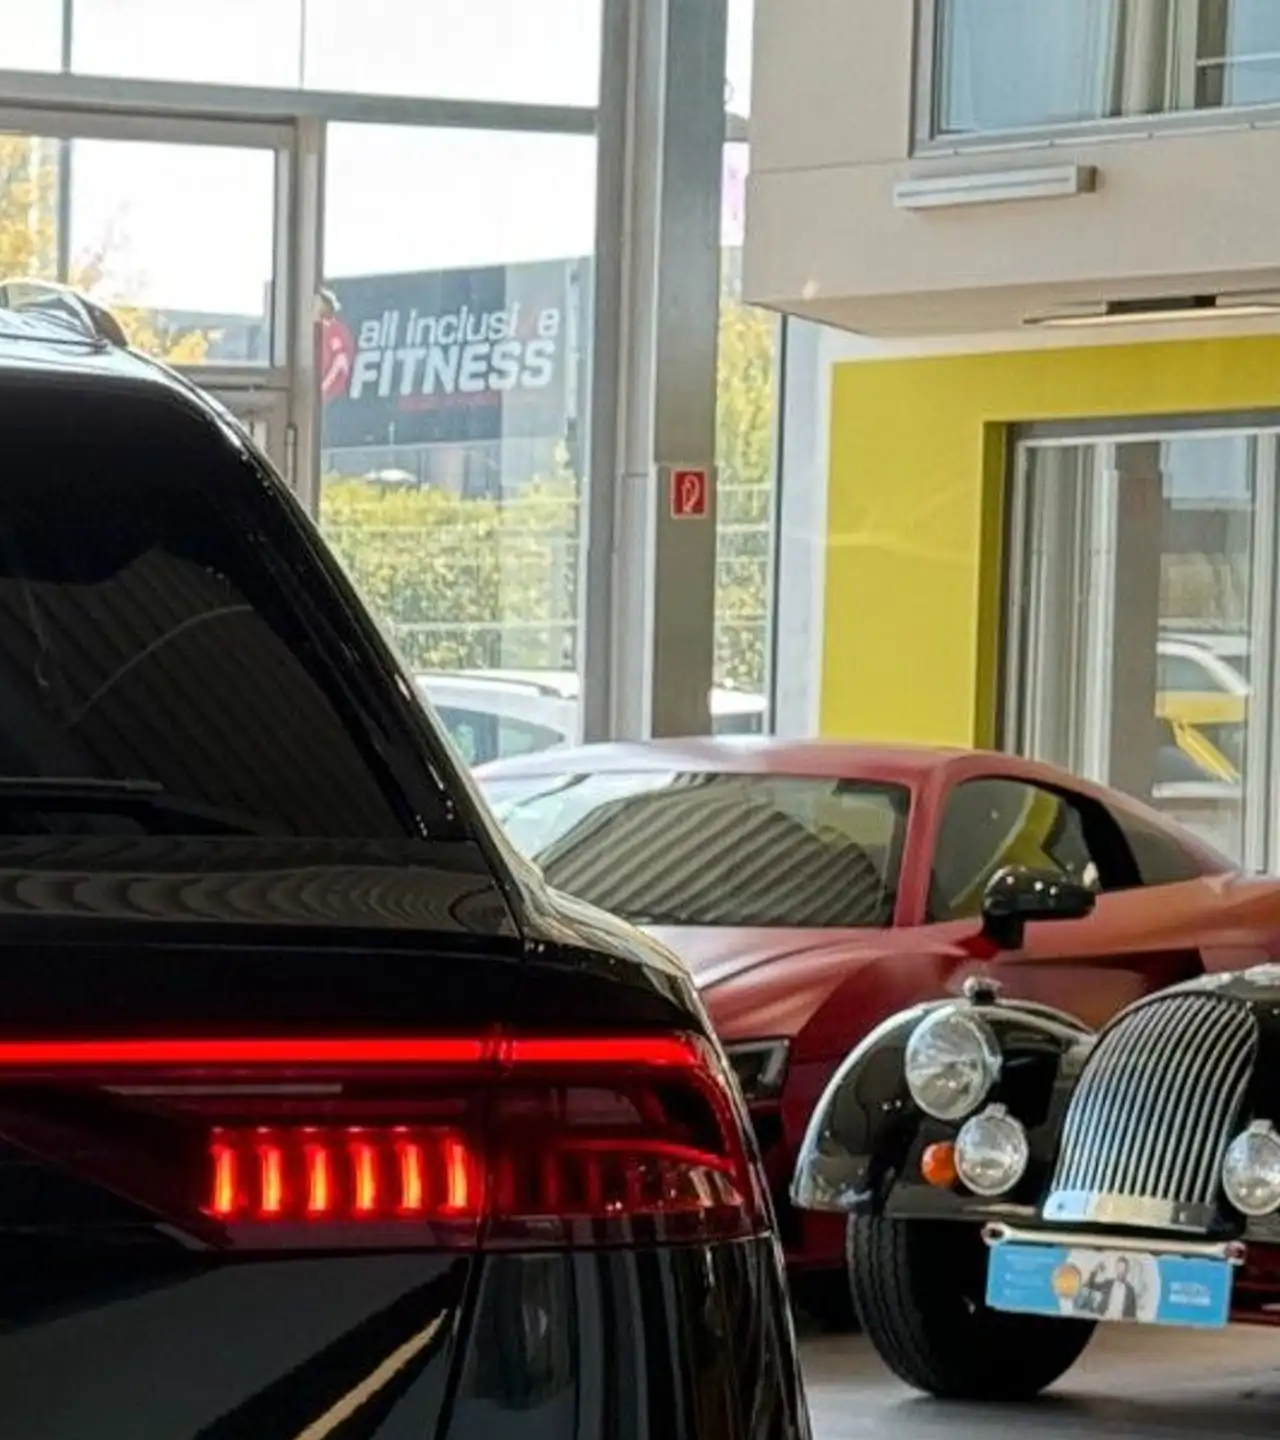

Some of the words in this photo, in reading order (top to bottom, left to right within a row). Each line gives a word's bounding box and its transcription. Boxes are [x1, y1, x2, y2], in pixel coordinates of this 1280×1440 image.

[358, 310, 400, 349] all
[406, 302, 560, 346] inclusie
[349, 340, 555, 400] FITNESS
